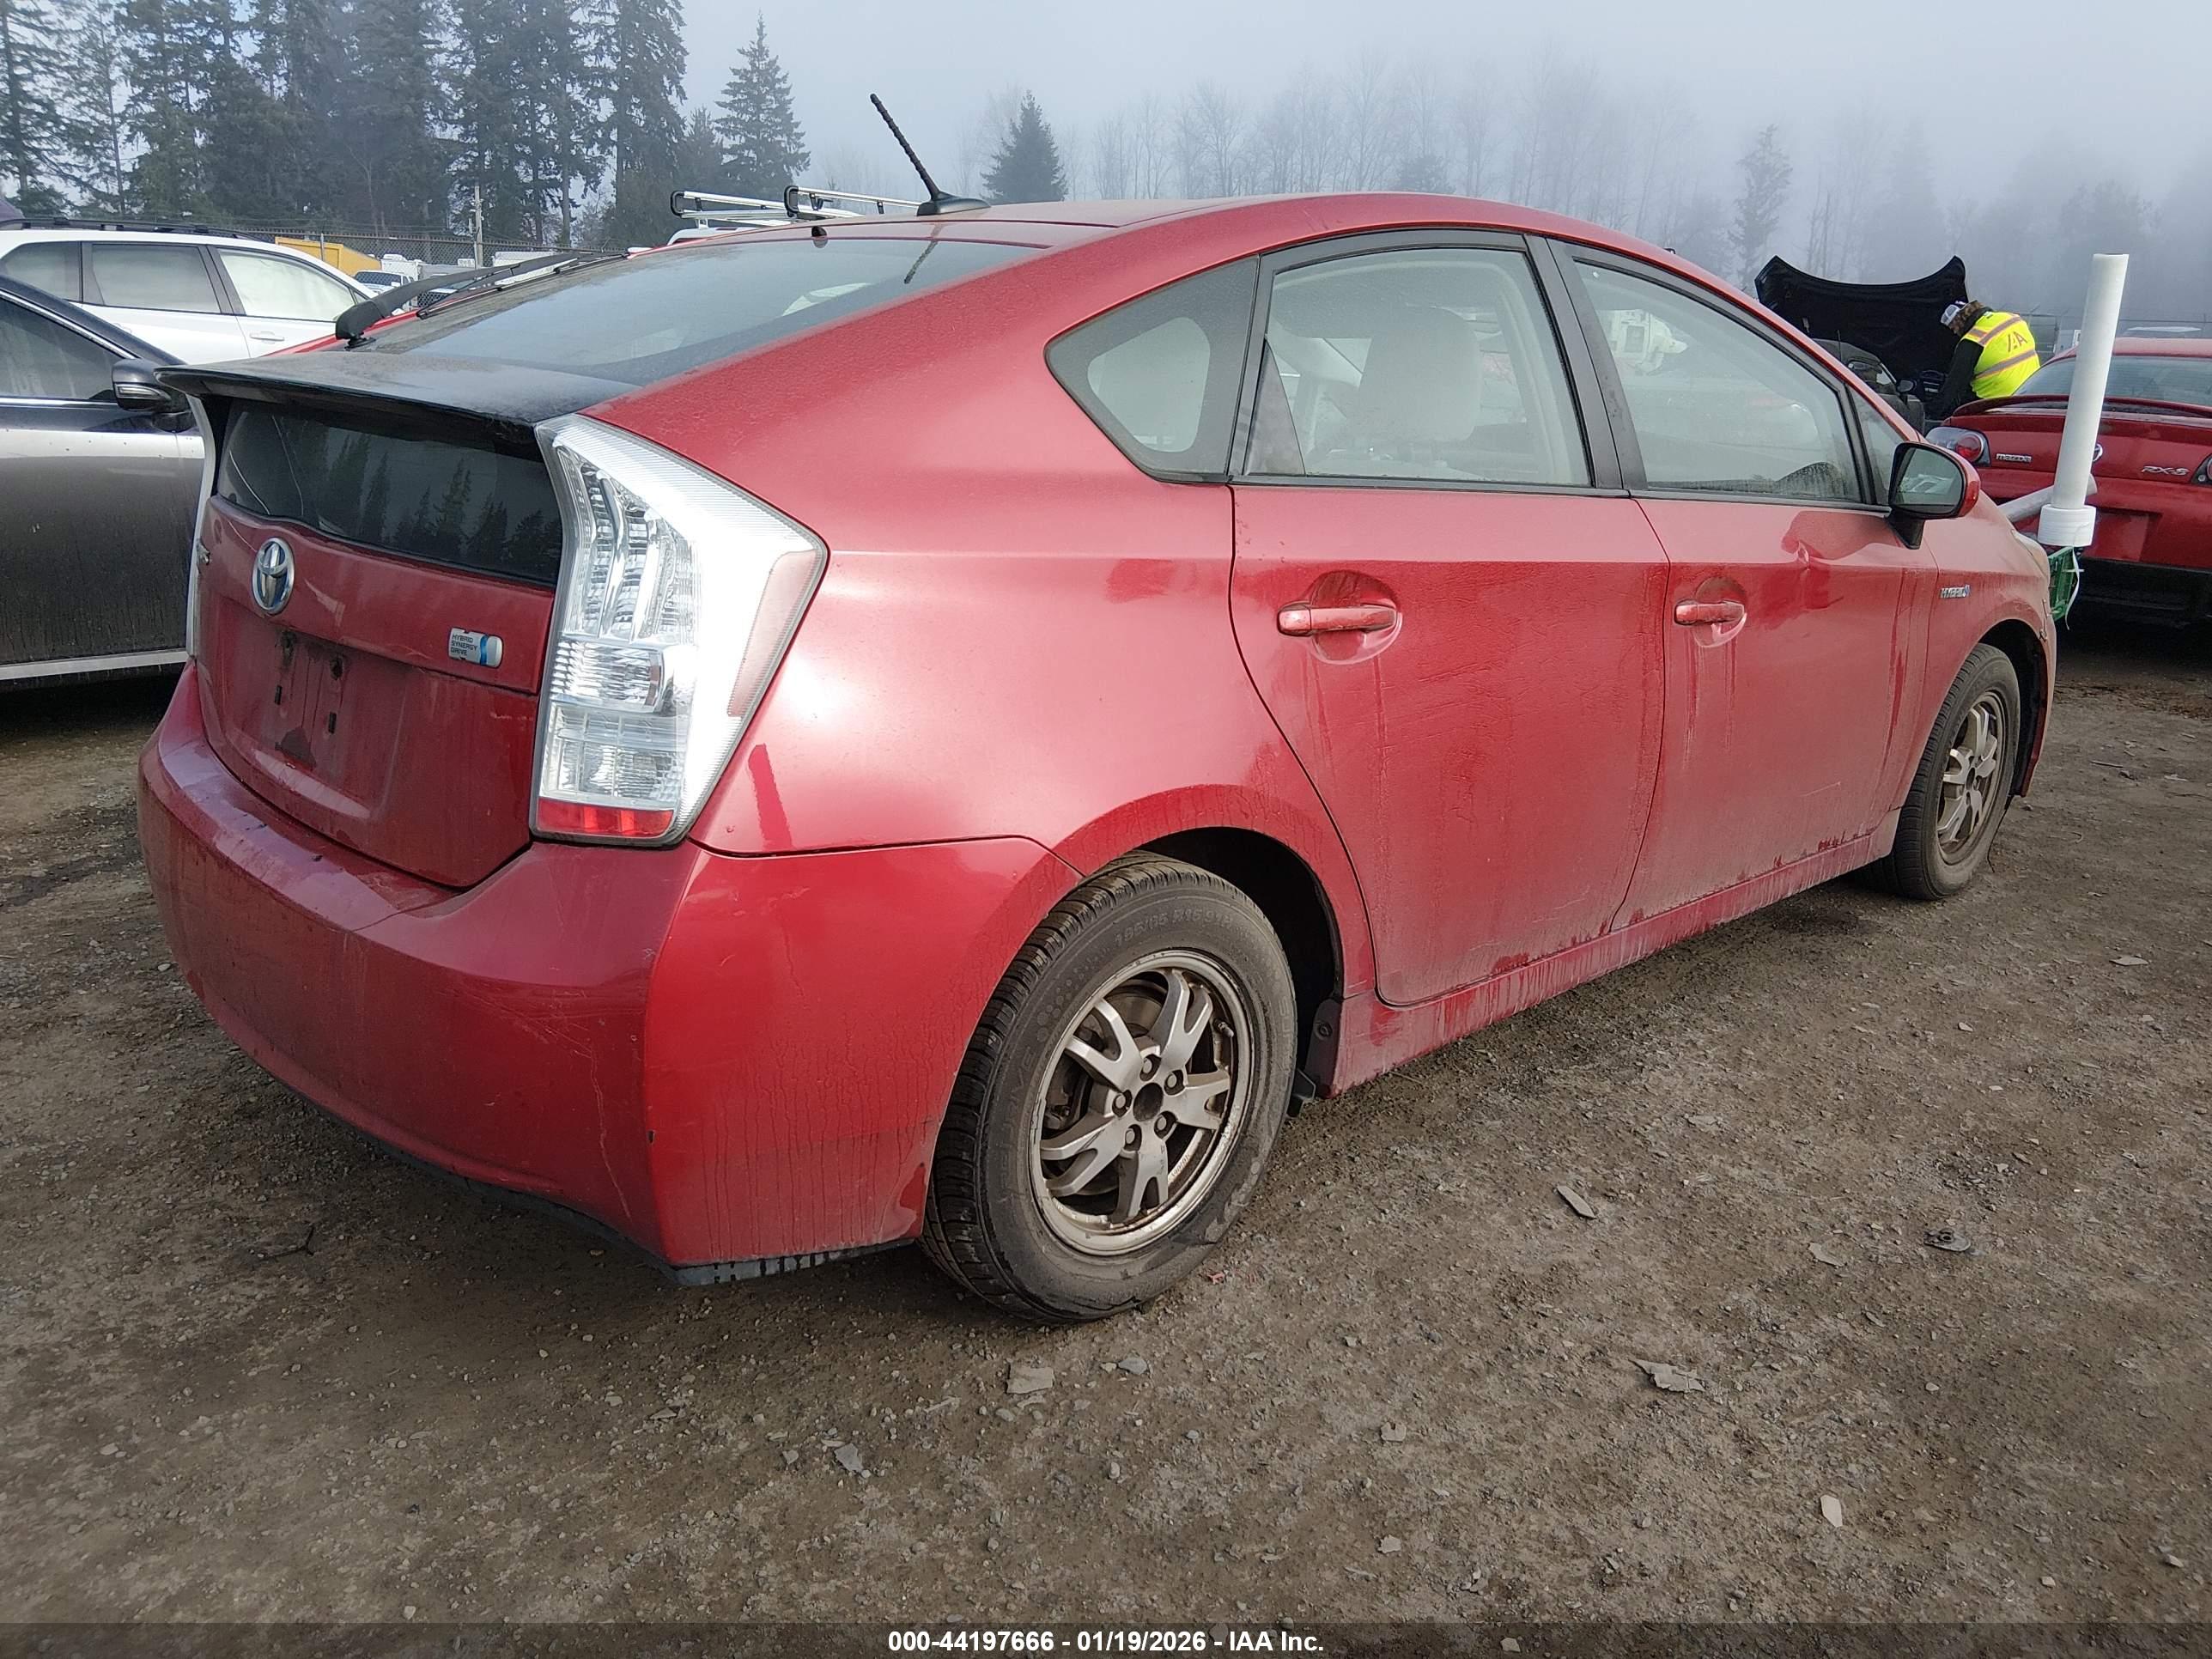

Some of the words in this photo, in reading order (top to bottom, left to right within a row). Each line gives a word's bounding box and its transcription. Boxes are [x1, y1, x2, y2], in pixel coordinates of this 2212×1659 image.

[1996, 453, 2032, 463] mazda
[452, 634, 473, 644] HYBRID
[451, 640, 477, 651] SYNERGY
[450, 647, 467, 656] DRIVE
